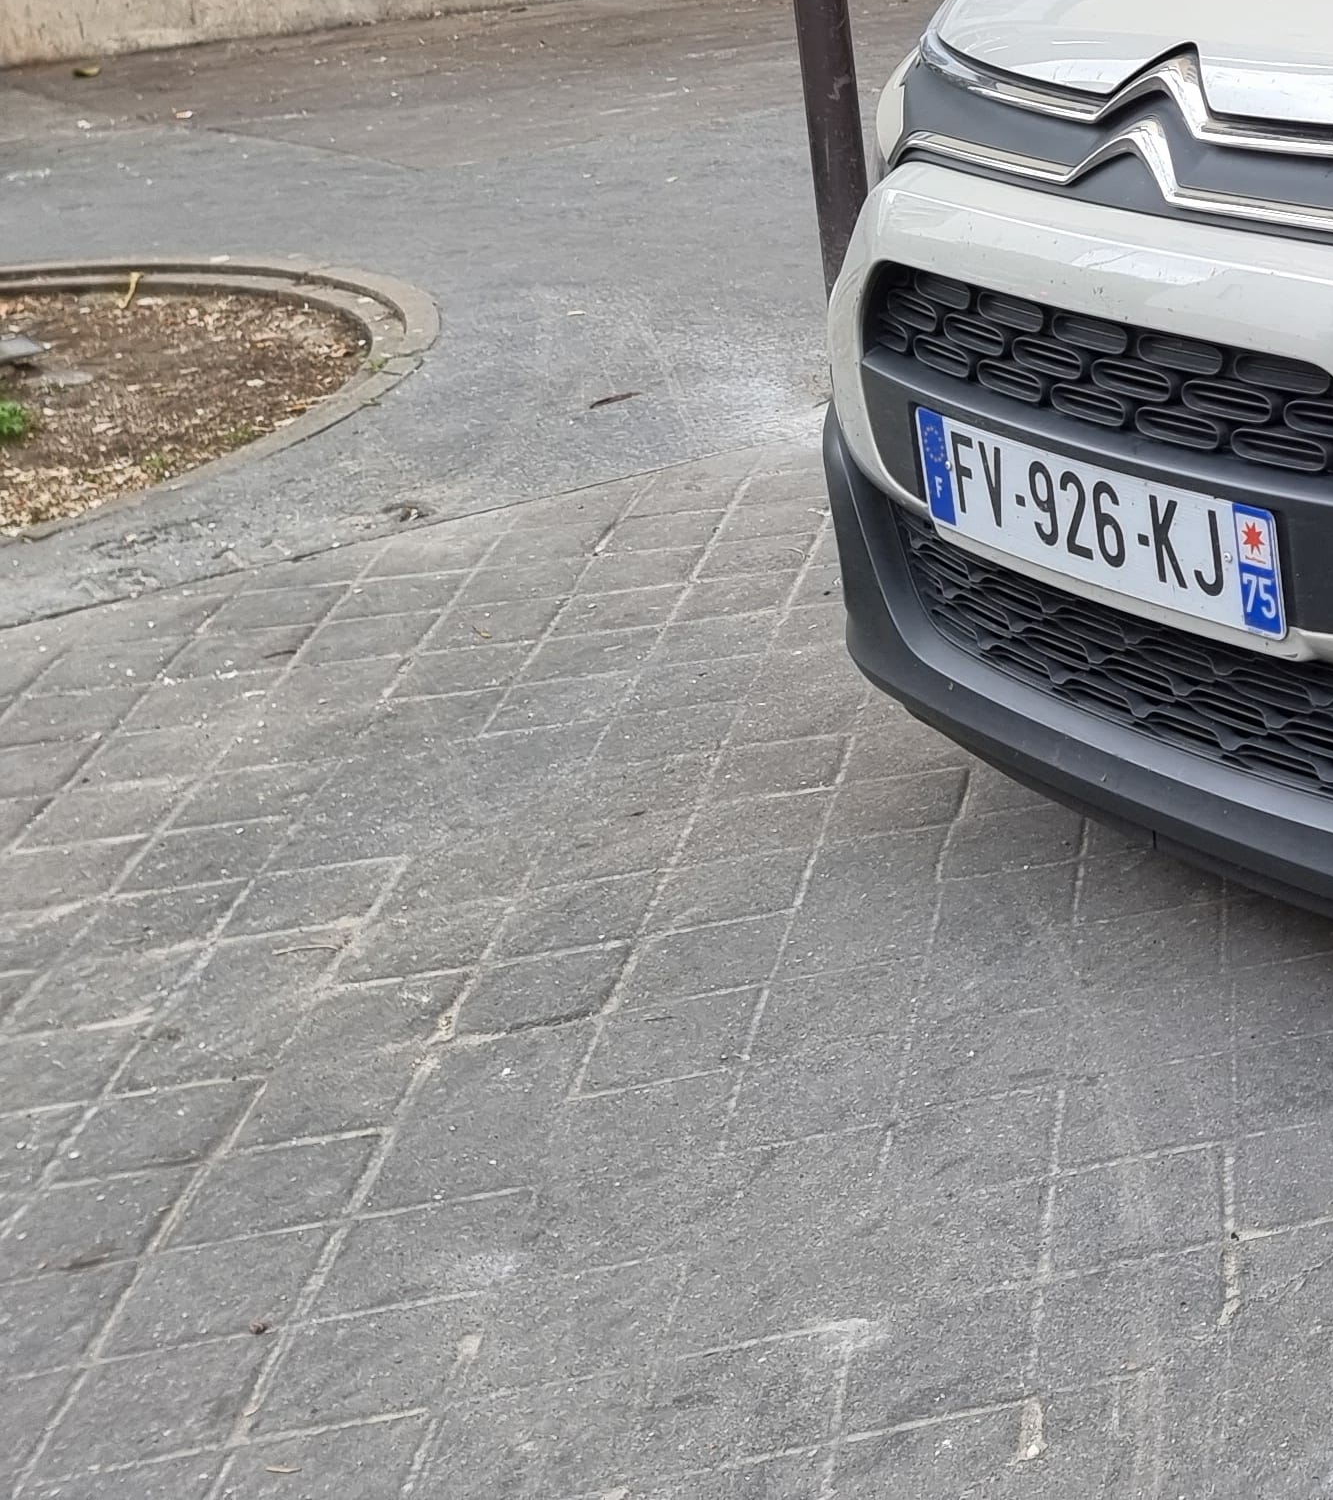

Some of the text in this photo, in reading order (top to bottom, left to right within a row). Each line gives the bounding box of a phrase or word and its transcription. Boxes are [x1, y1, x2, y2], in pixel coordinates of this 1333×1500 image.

[934, 475, 944, 499] F
[950, 430, 1225, 598] FV-926-KJ
[1242, 572, 1277, 620] 75
